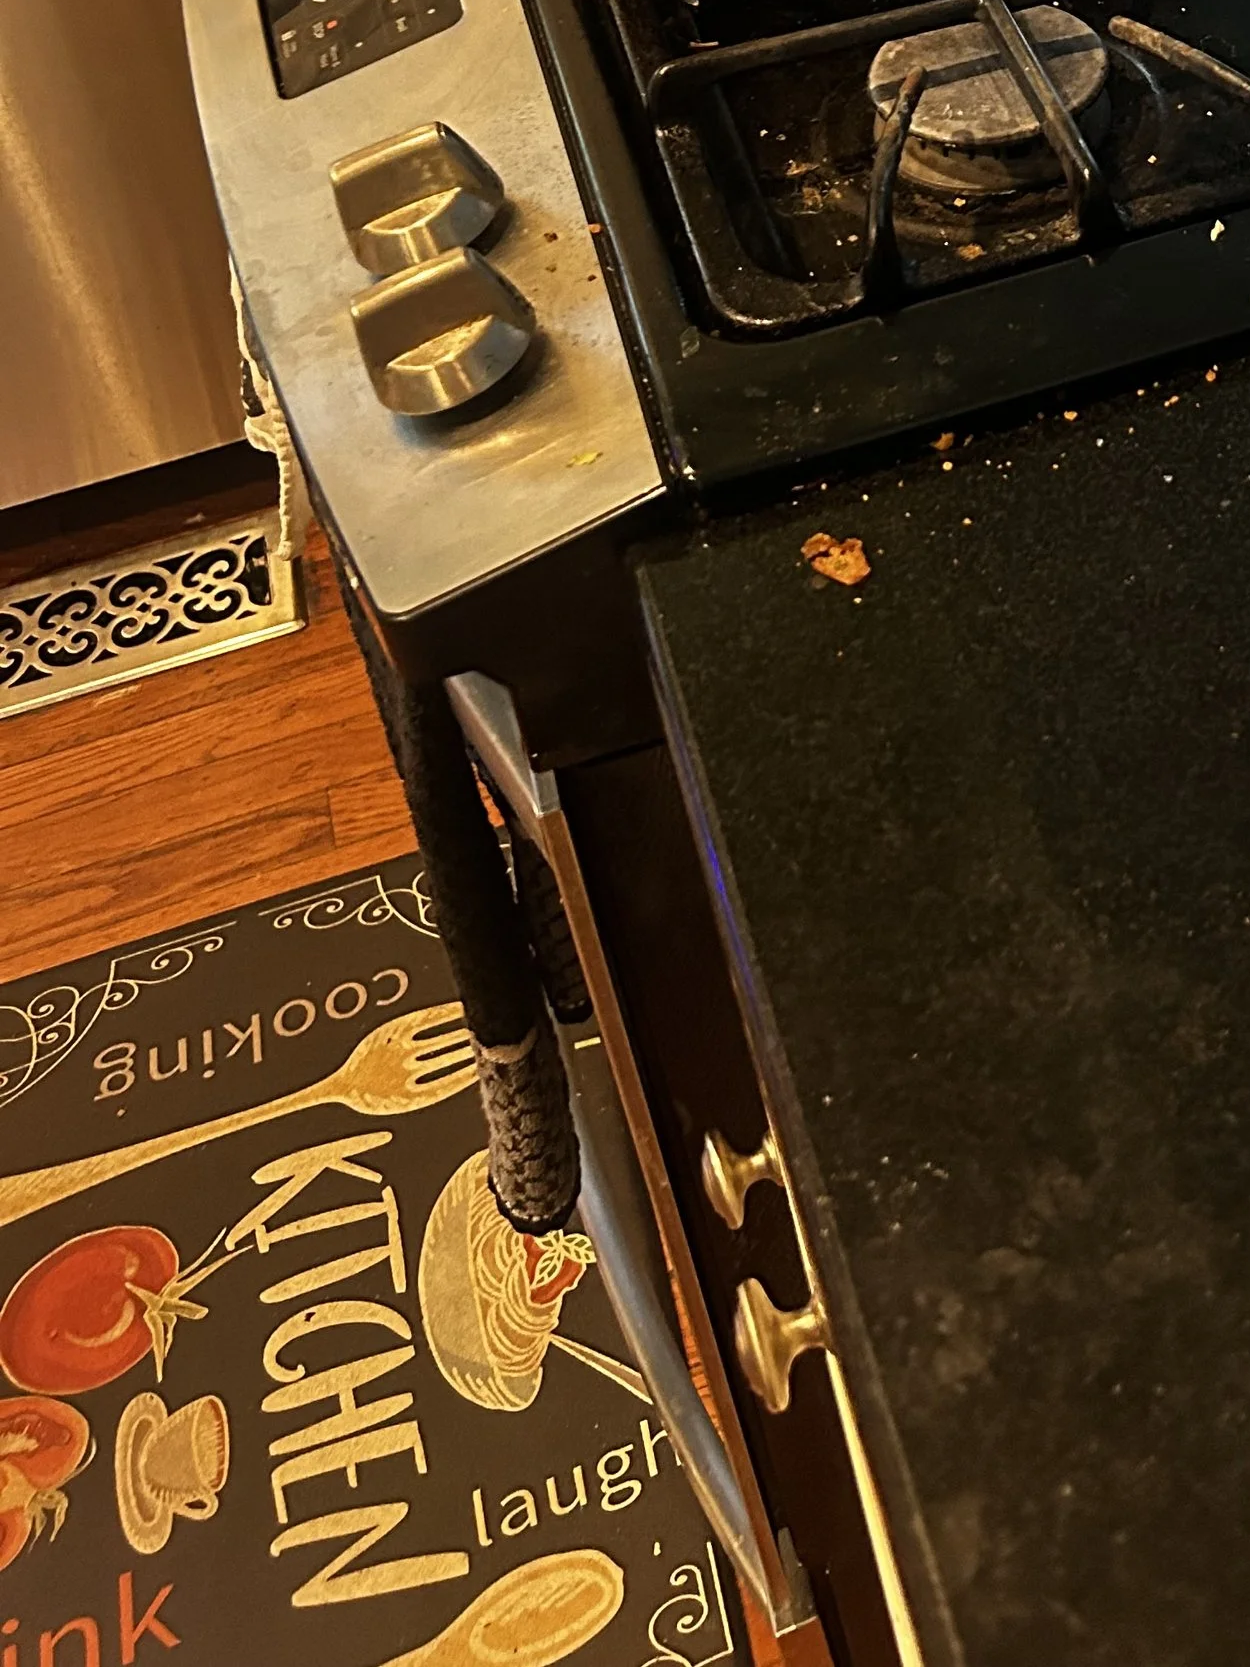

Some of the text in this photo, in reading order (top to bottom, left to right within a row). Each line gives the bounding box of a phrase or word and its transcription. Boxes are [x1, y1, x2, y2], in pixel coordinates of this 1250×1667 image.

[93, 968, 409, 1102] cooking
[226, 1130, 470, 1609] KITCHEN
[472, 1419, 683, 1547] laugh
